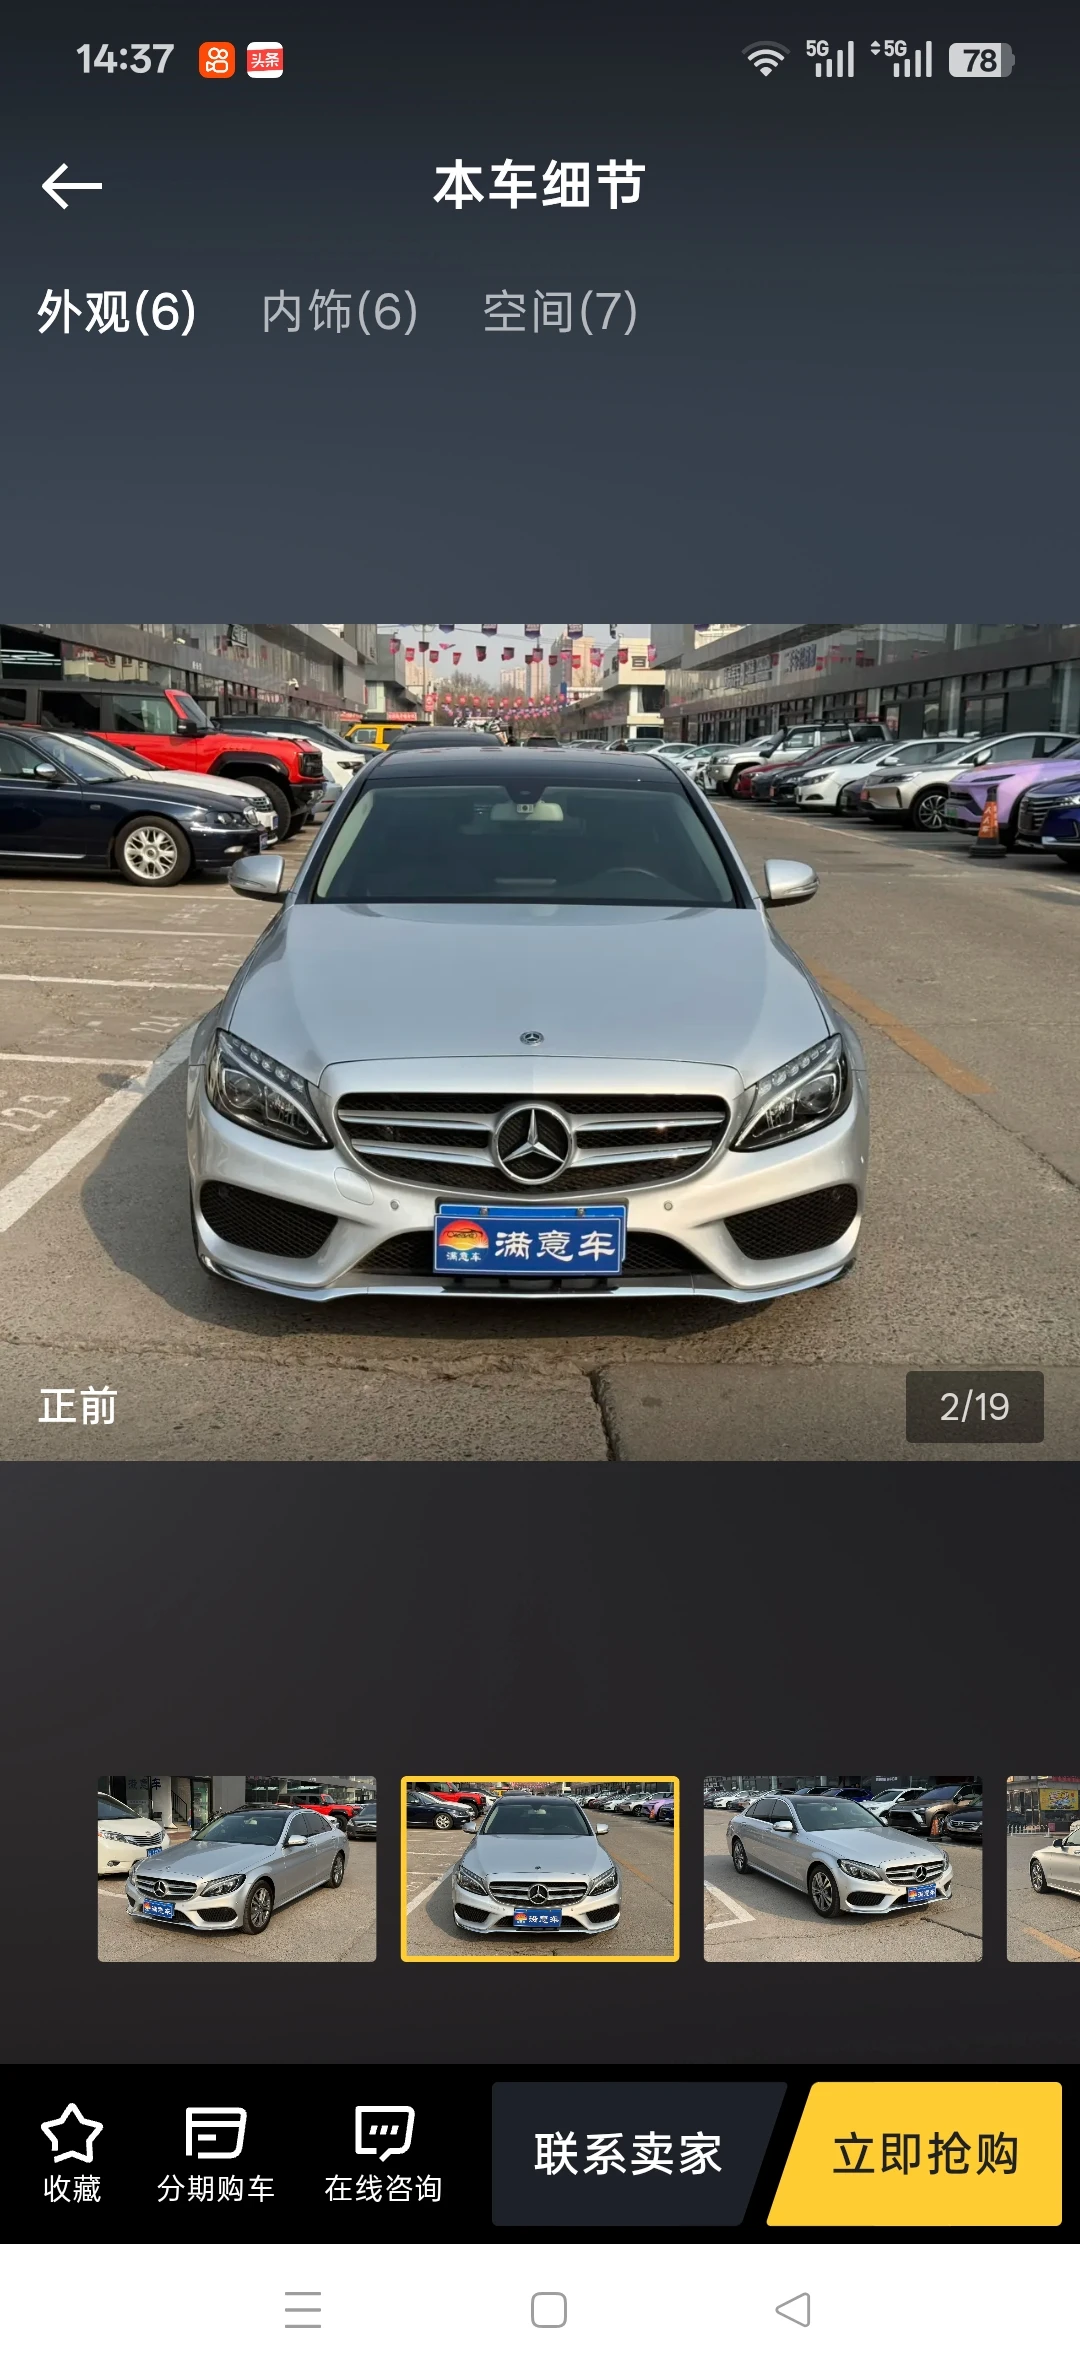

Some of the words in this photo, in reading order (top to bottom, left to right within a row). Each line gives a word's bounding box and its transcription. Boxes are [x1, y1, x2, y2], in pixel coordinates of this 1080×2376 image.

[76, 43, 175, 74] 14:37
[251, 52, 280, 69] 头条
[806, 39, 830, 57] 5G
[884, 39, 908, 57] 5G
[963, 48, 997, 72] 78
[432, 157, 646, 210] 本车细节
[36, 288, 195, 337] 外观(6)
[263, 288, 418, 337] 内饰(6)
[483, 288, 638, 337] 空间(7)
[494, 1229, 616, 1262] 满意车
[533, 2130, 723, 2177] 联系卖家
[832, 2130, 1018, 2177] 立即抢购
[43, 2173, 102, 2204] 收藏
[156, 2173, 275, 2203] 分期购车
[324, 2173, 442, 2203] 在线咨询
